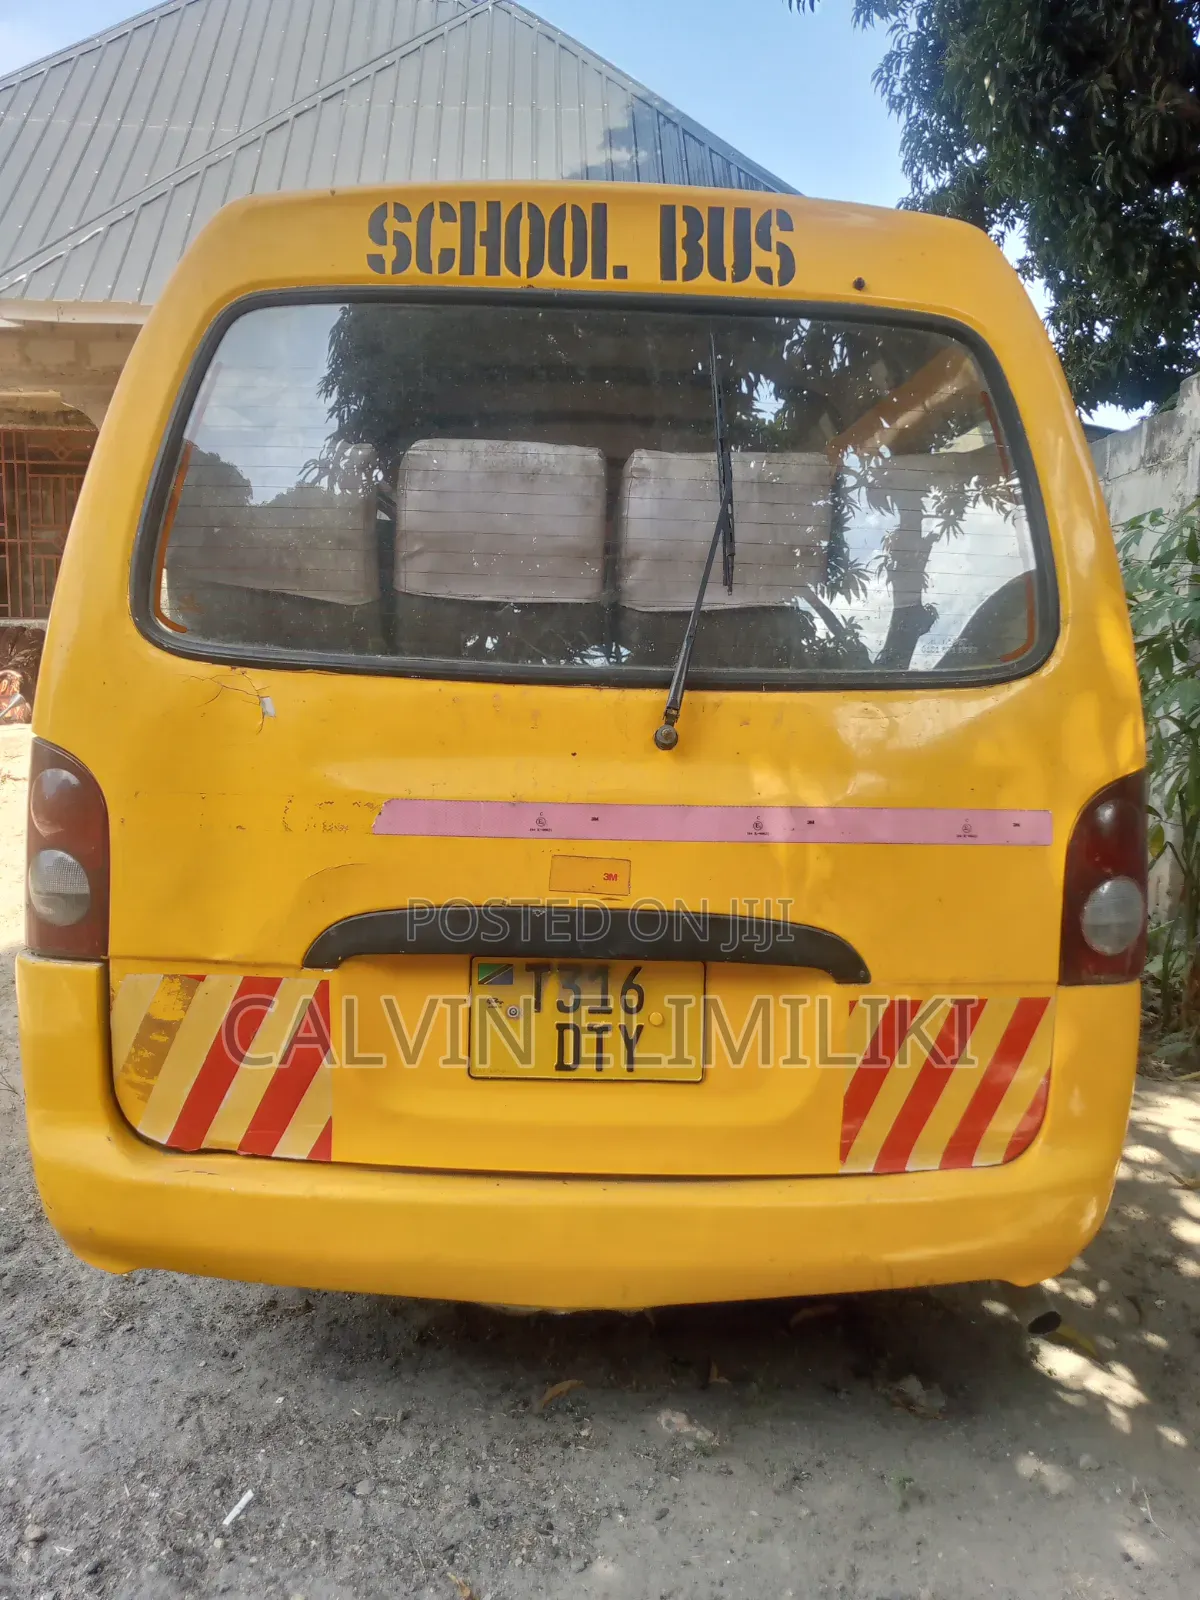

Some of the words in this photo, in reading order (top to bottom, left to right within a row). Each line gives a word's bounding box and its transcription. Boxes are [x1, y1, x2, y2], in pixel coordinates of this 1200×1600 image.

[366, 200, 628, 280] SCHOOL
[660, 203, 797, 288] BUS
[603, 872, 618, 882] 3M
[525, 963, 645, 1015] T316
[554, 1022, 644, 1073] DTY
